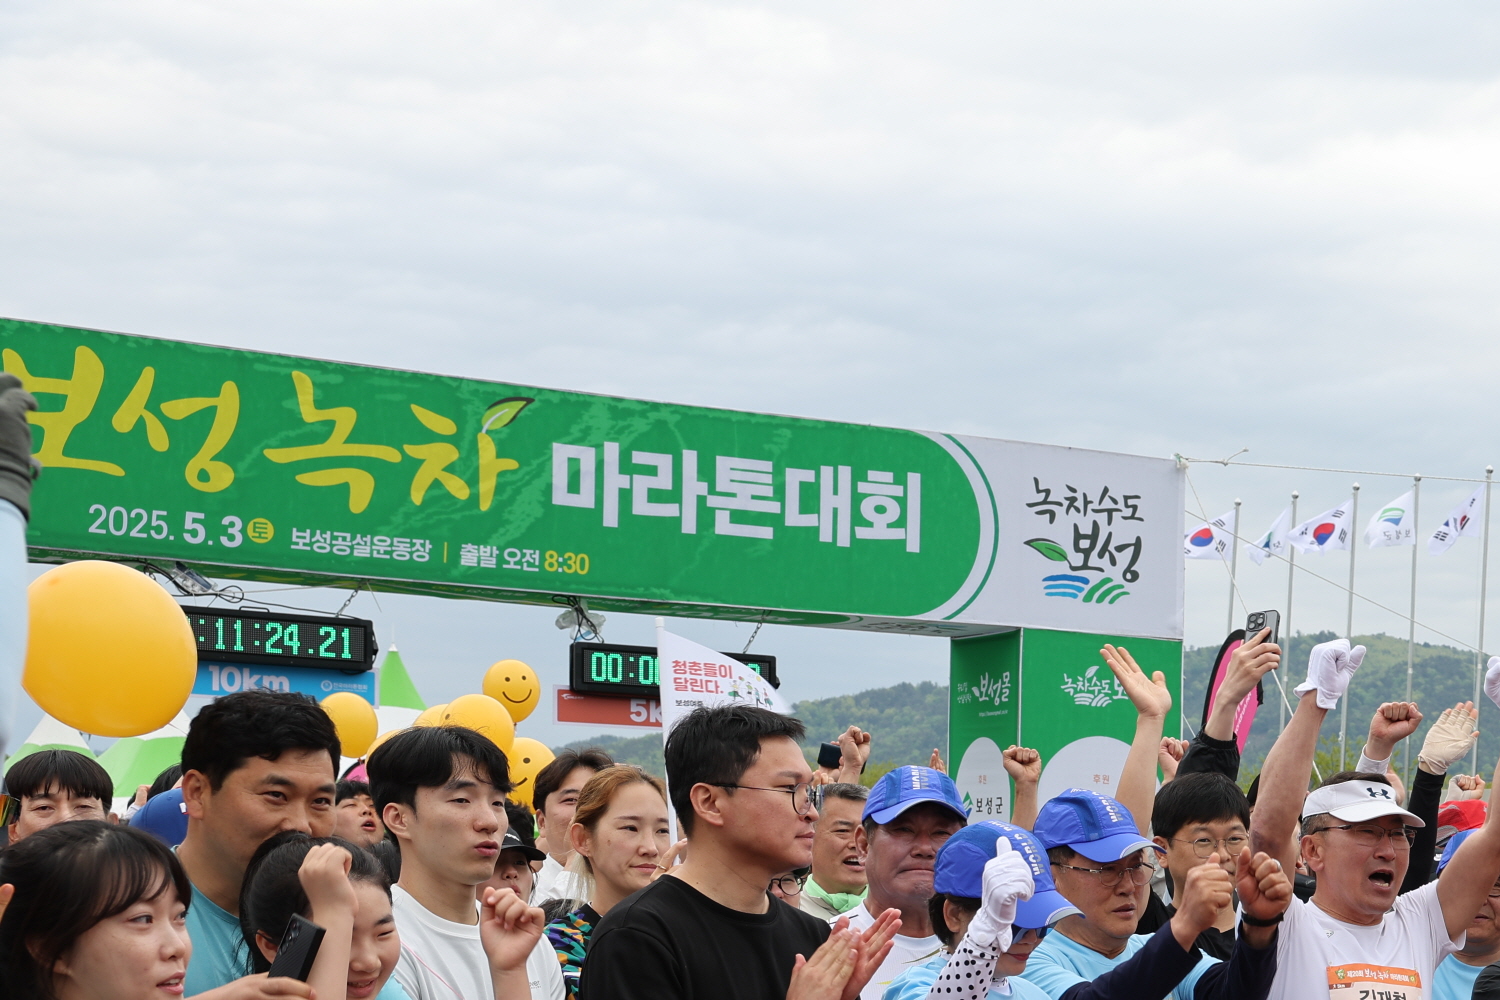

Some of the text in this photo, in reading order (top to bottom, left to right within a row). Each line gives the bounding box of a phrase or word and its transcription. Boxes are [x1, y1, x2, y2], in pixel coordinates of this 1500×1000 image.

[263, 370, 519, 514] 녹차
[552, 441, 922, 553] 마라톤대회
[1026, 477, 1145, 526] 녹차수도
[291, 528, 432, 564] 보성공설운동장
[460, 543, 499, 568] 출발
[502, 547, 540, 573] 오전
[544, 550, 590, 575] 8:30
[1069, 519, 1143, 583] 보성
[209, 665, 290, 693] 10km
[672, 659, 733, 679] 청춘들이
[1061, 673, 1112, 696] 녹차수도
[673, 677, 725, 694] 달린다.
[979, 672, 1011, 706] 보성몰
[976, 797, 1003, 815] 보성군
